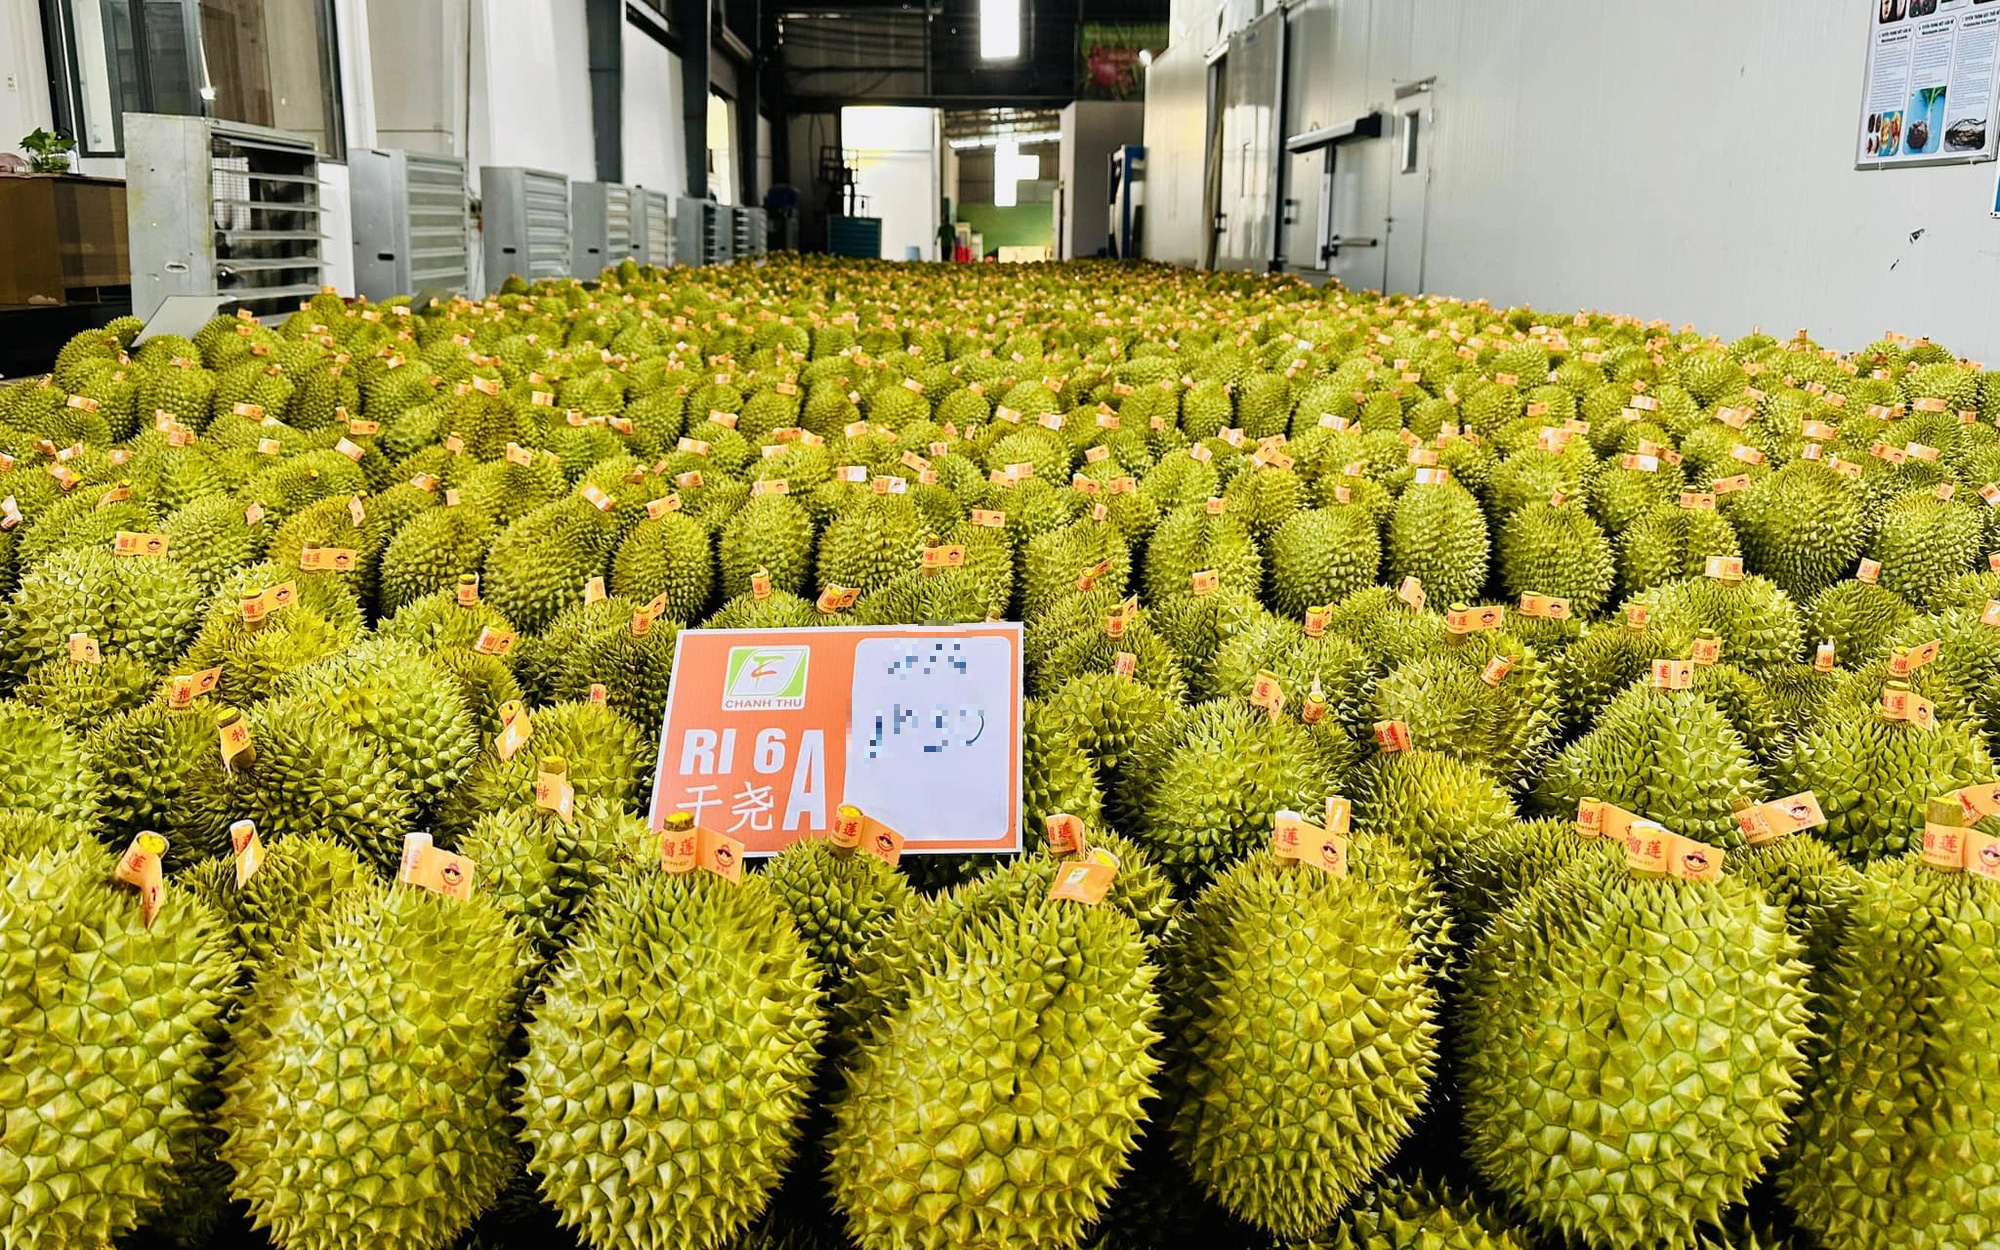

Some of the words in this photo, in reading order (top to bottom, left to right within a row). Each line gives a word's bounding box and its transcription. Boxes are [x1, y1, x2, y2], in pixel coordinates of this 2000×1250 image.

[725, 699, 771, 709] CHANH
[775, 699, 802, 708] THU
[679, 728, 737, 775] RI
[753, 727, 786, 775] 6
[781, 729, 827, 831] A
